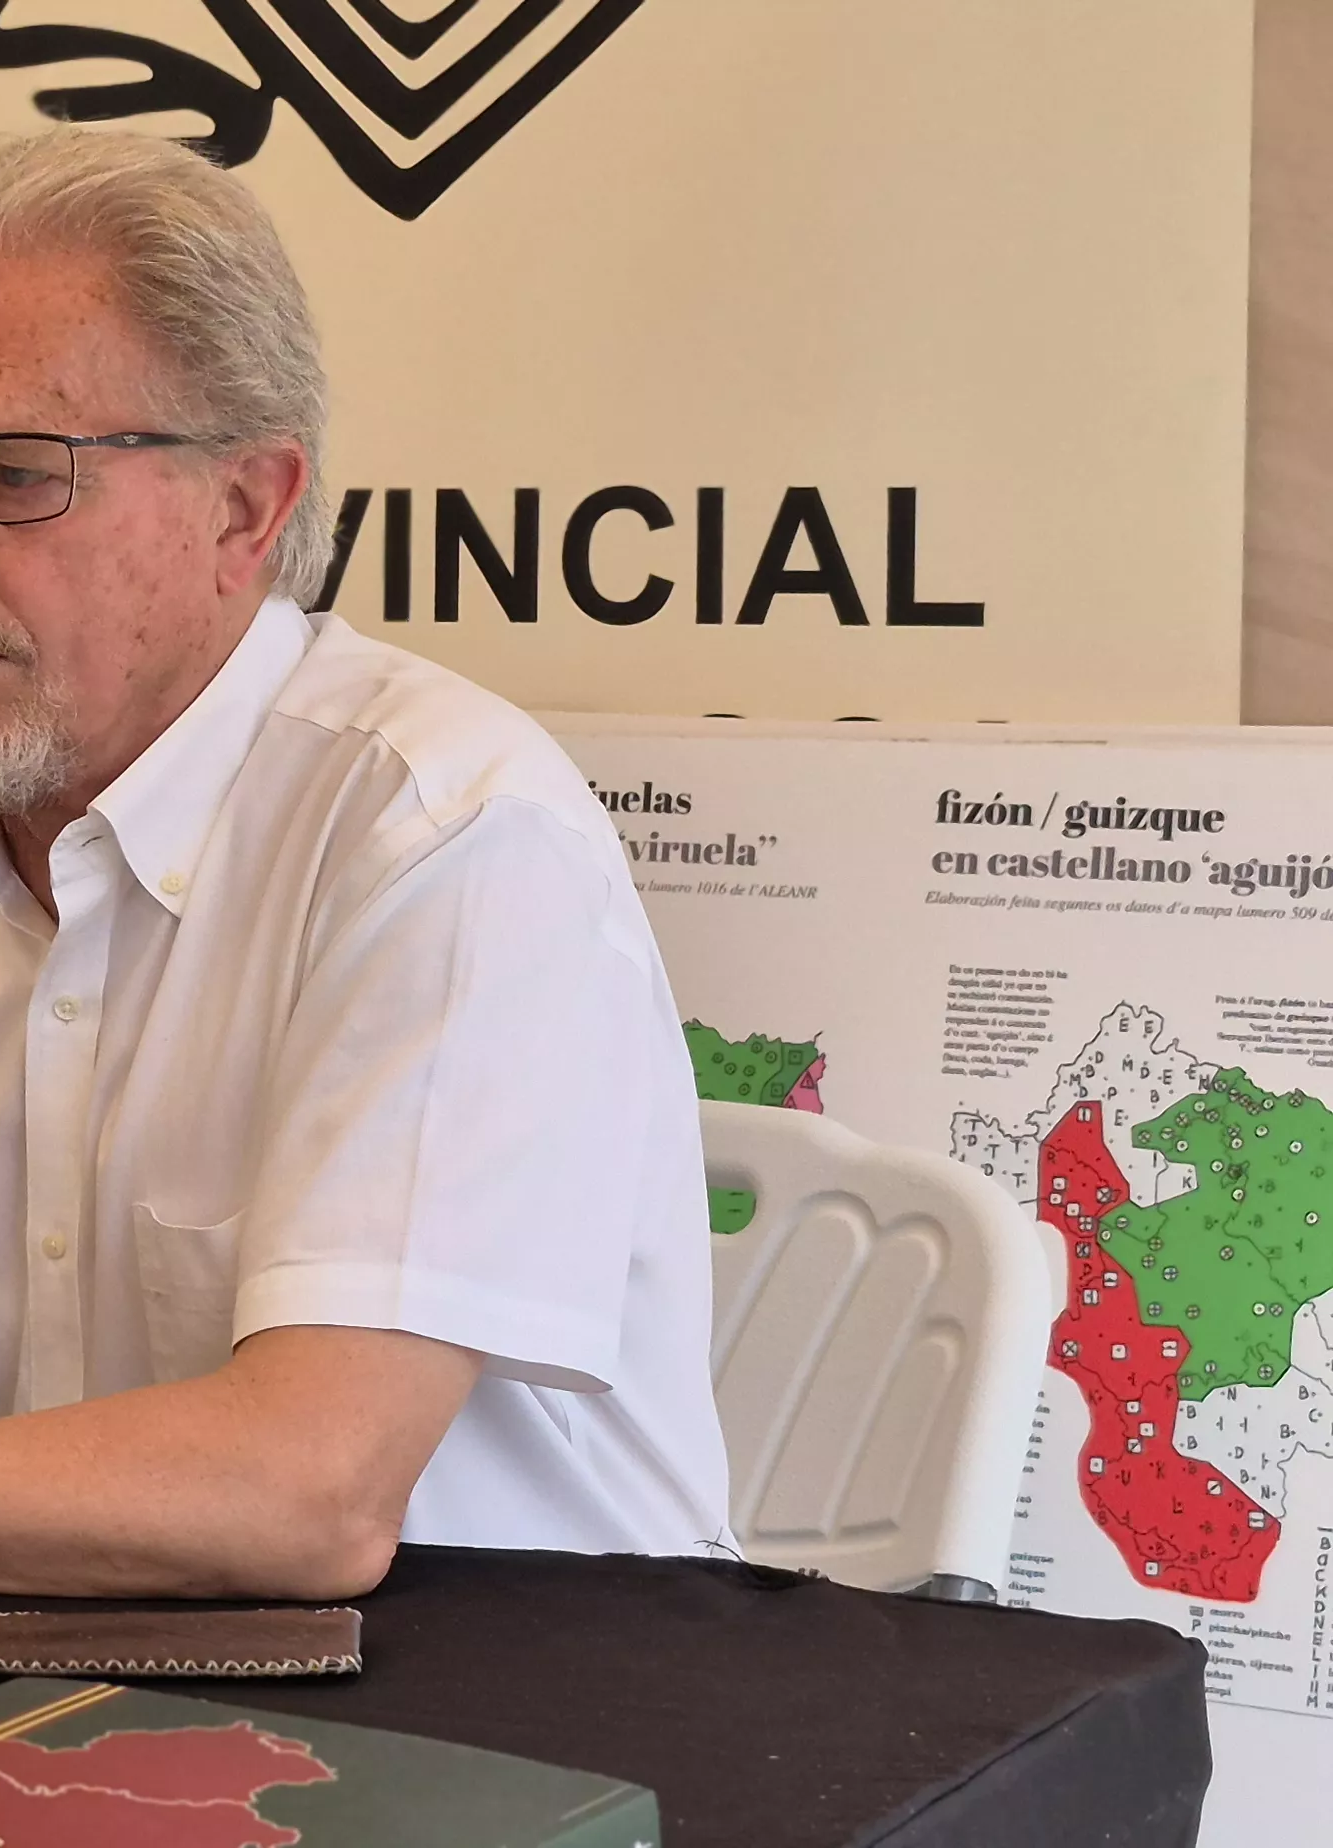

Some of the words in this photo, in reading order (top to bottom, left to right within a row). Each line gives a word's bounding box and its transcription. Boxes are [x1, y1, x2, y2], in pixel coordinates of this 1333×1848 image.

[318, 486, 985, 627] VINCIAL
[935, 789, 1033, 827] fizón
[1062, 796, 1225, 841] guizque
[697, 881, 727, 895] 1016
[931, 850, 978, 875] en
[987, 846, 1191, 883] castellano
[1201, 850, 1333, 899] ‘aguijó
[1125, 900, 1162, 913] datos
[1194, 905, 1233, 919] mapa
[1290, 906, 1317, 920] 509
